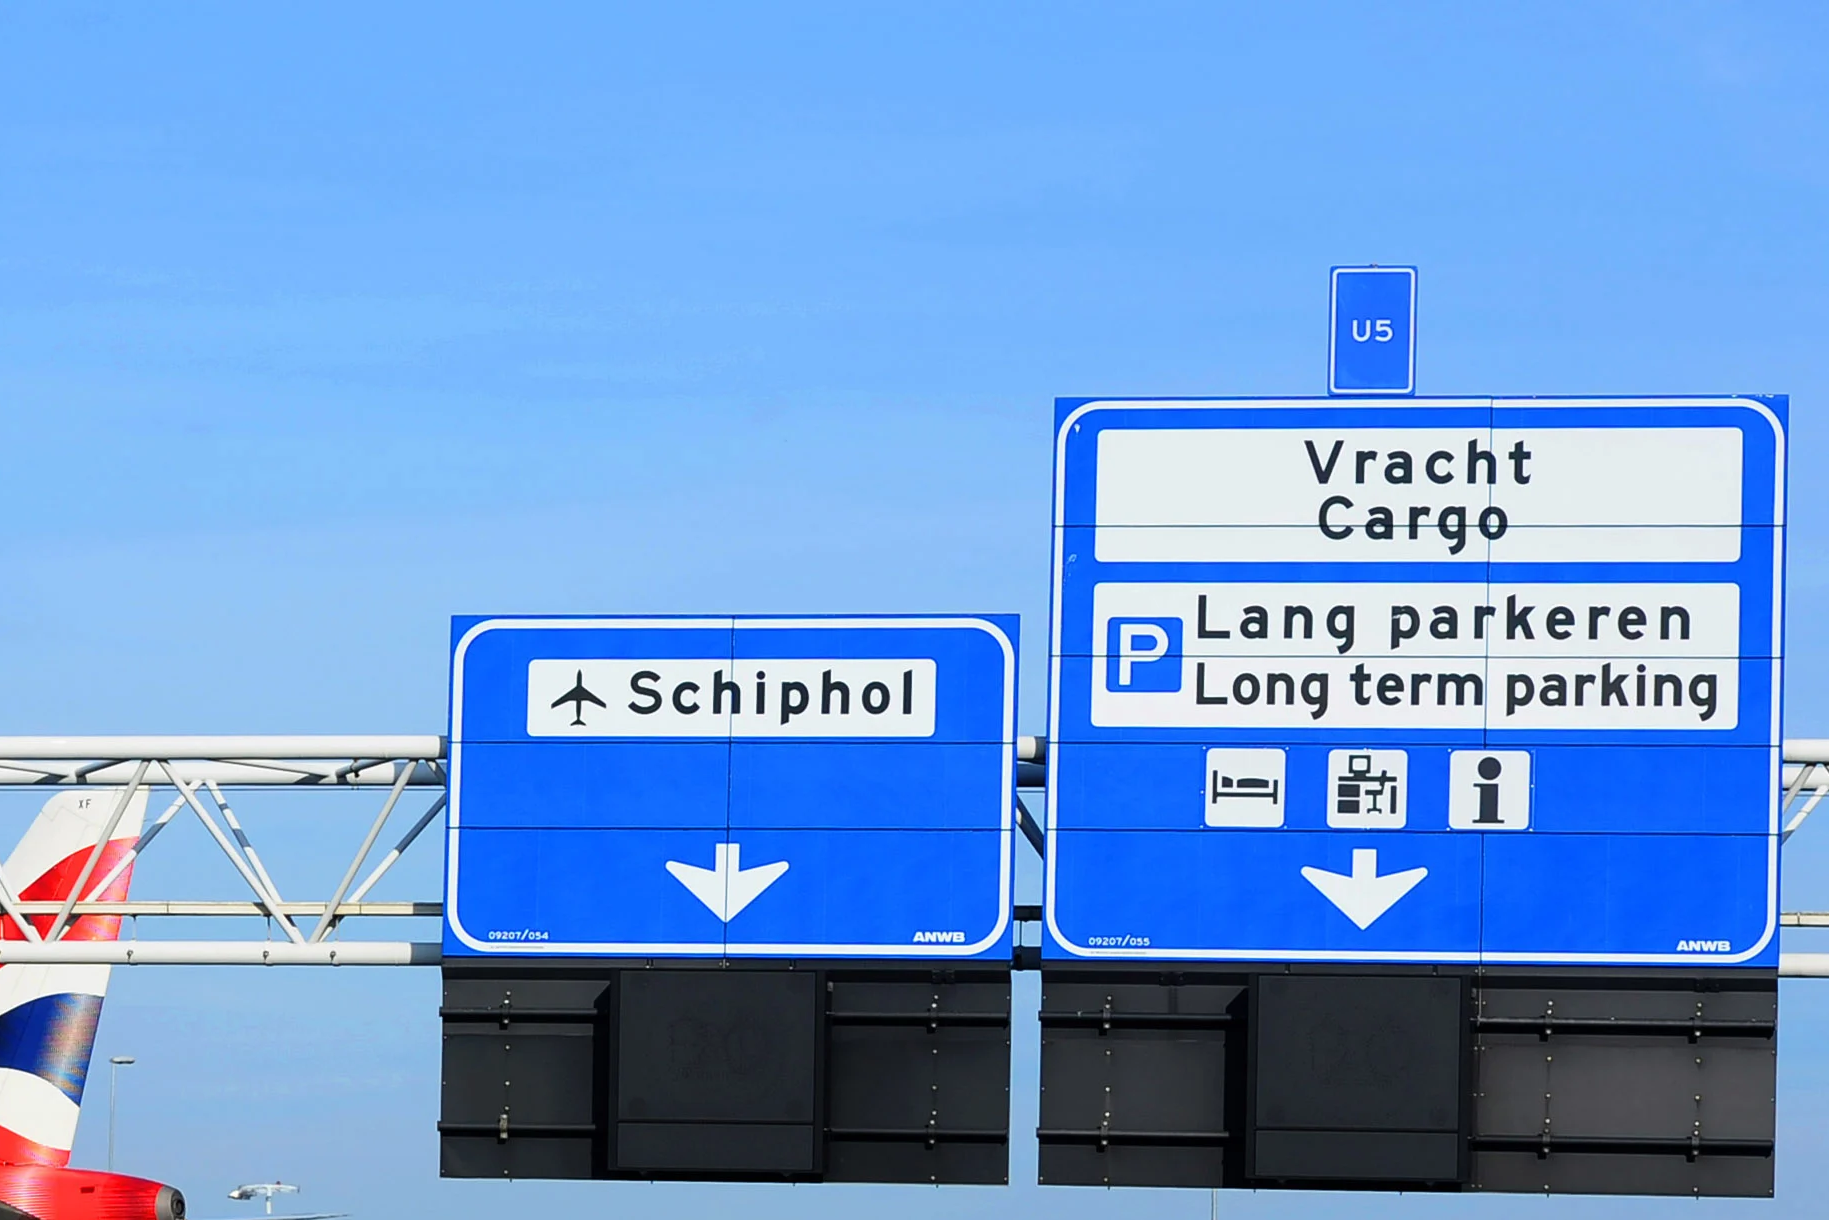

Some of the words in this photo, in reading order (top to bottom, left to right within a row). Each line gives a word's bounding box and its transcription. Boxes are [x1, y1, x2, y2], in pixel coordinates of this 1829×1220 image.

[1353, 319, 1393, 342] U5
[1304, 439, 1532, 485] Vracht
[1317, 496, 1509, 555] Cargo
[1197, 595, 1355, 654] Lang
[1390, 595, 1691, 650] parkeren
[628, 670, 913, 725] Schiphol
[1196, 663, 1330, 720] Long
[1349, 664, 1484, 706] term
[1506, 663, 1718, 722] parking
[78, 798, 92, 809] XF
[488, 929, 549, 940] 09207/054
[913, 931, 966, 943] ANWB
[1088, 934, 1150, 947] 09207/055
[1676, 939, 1732, 952] ANWB
